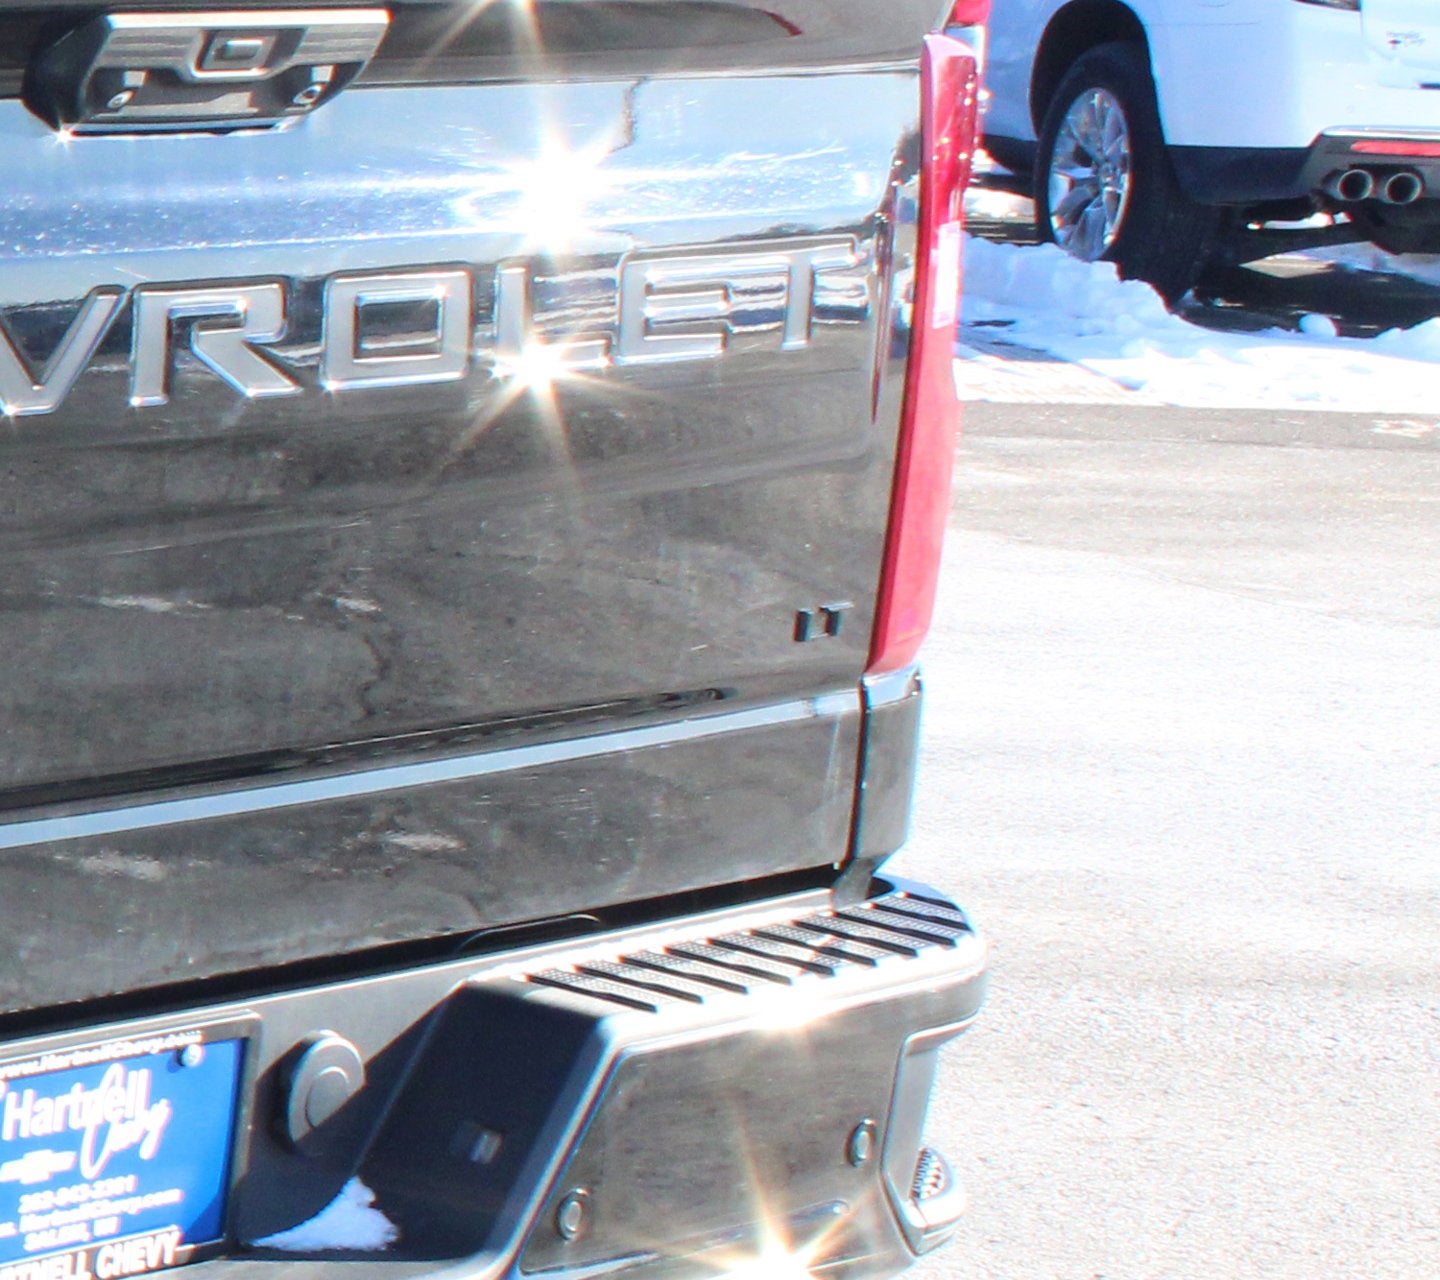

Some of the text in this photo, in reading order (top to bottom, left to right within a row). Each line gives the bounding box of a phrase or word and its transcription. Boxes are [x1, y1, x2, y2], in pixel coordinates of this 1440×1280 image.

[793, 601, 854, 642] LT
[1, 1068, 152, 1141] Hartnell
[96, 1229, 182, 1280] CHEVY
